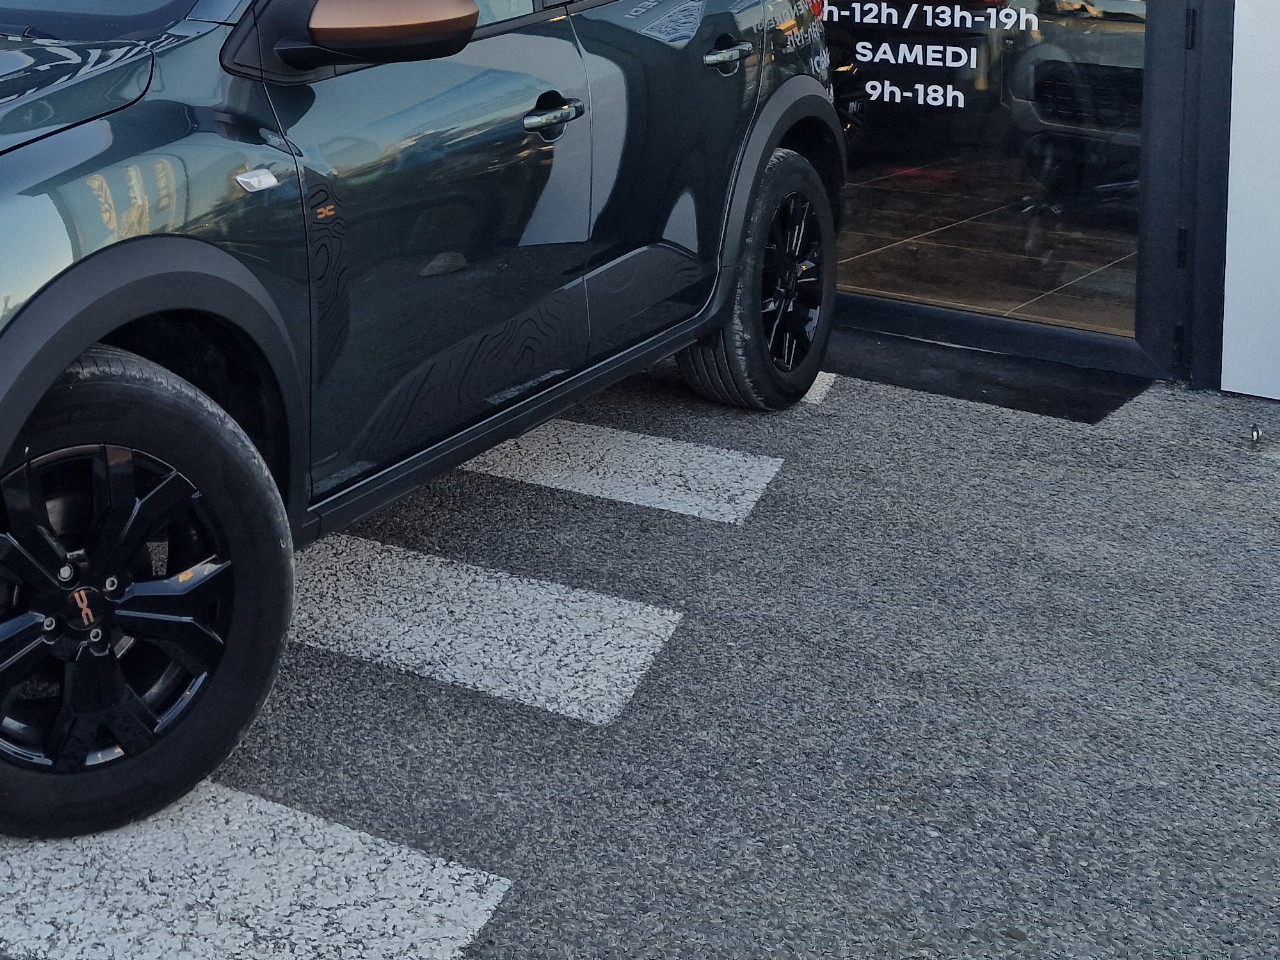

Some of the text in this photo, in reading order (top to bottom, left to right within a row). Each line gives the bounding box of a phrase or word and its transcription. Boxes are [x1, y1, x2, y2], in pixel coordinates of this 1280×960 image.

[923, 5, 1039, 32] 13h-19h
[855, 41, 977, 69] SAMEDI
[865, 80, 965, 109] 9h-18h
